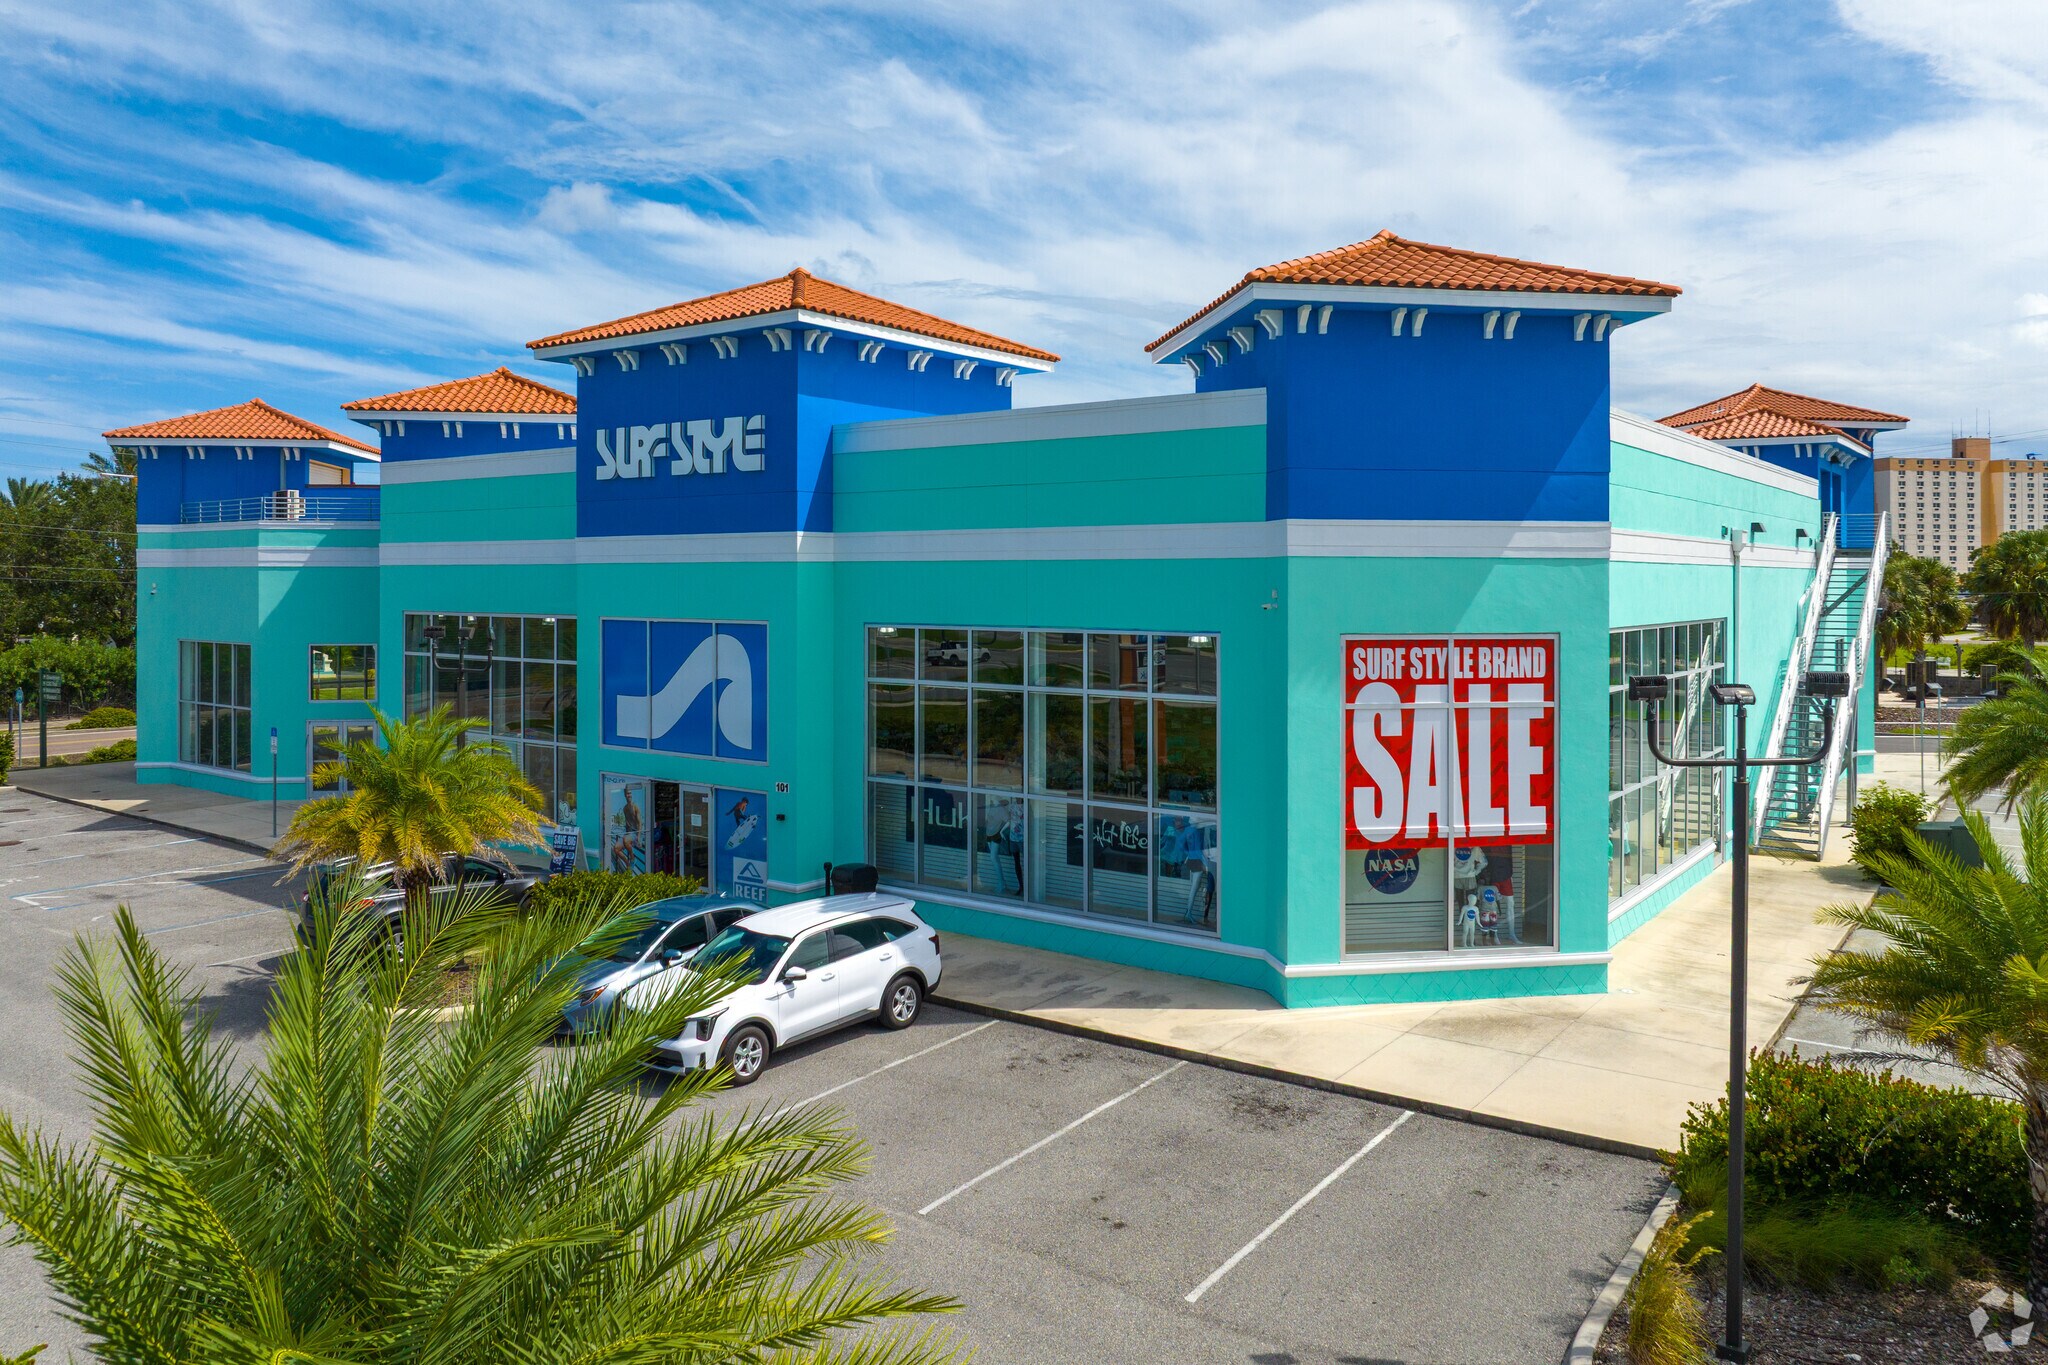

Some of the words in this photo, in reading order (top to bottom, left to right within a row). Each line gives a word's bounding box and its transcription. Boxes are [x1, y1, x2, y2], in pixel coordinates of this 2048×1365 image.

[1353, 647, 1405, 680] SURF
[1410, 647, 1474, 679] STYLE
[1478, 647, 1546, 679] BRAND
[1353, 682, 1547, 843] SALE
[776, 782, 789, 793] 101
[1368, 858, 1417, 872] NASA
[735, 883, 766, 901] REEF
